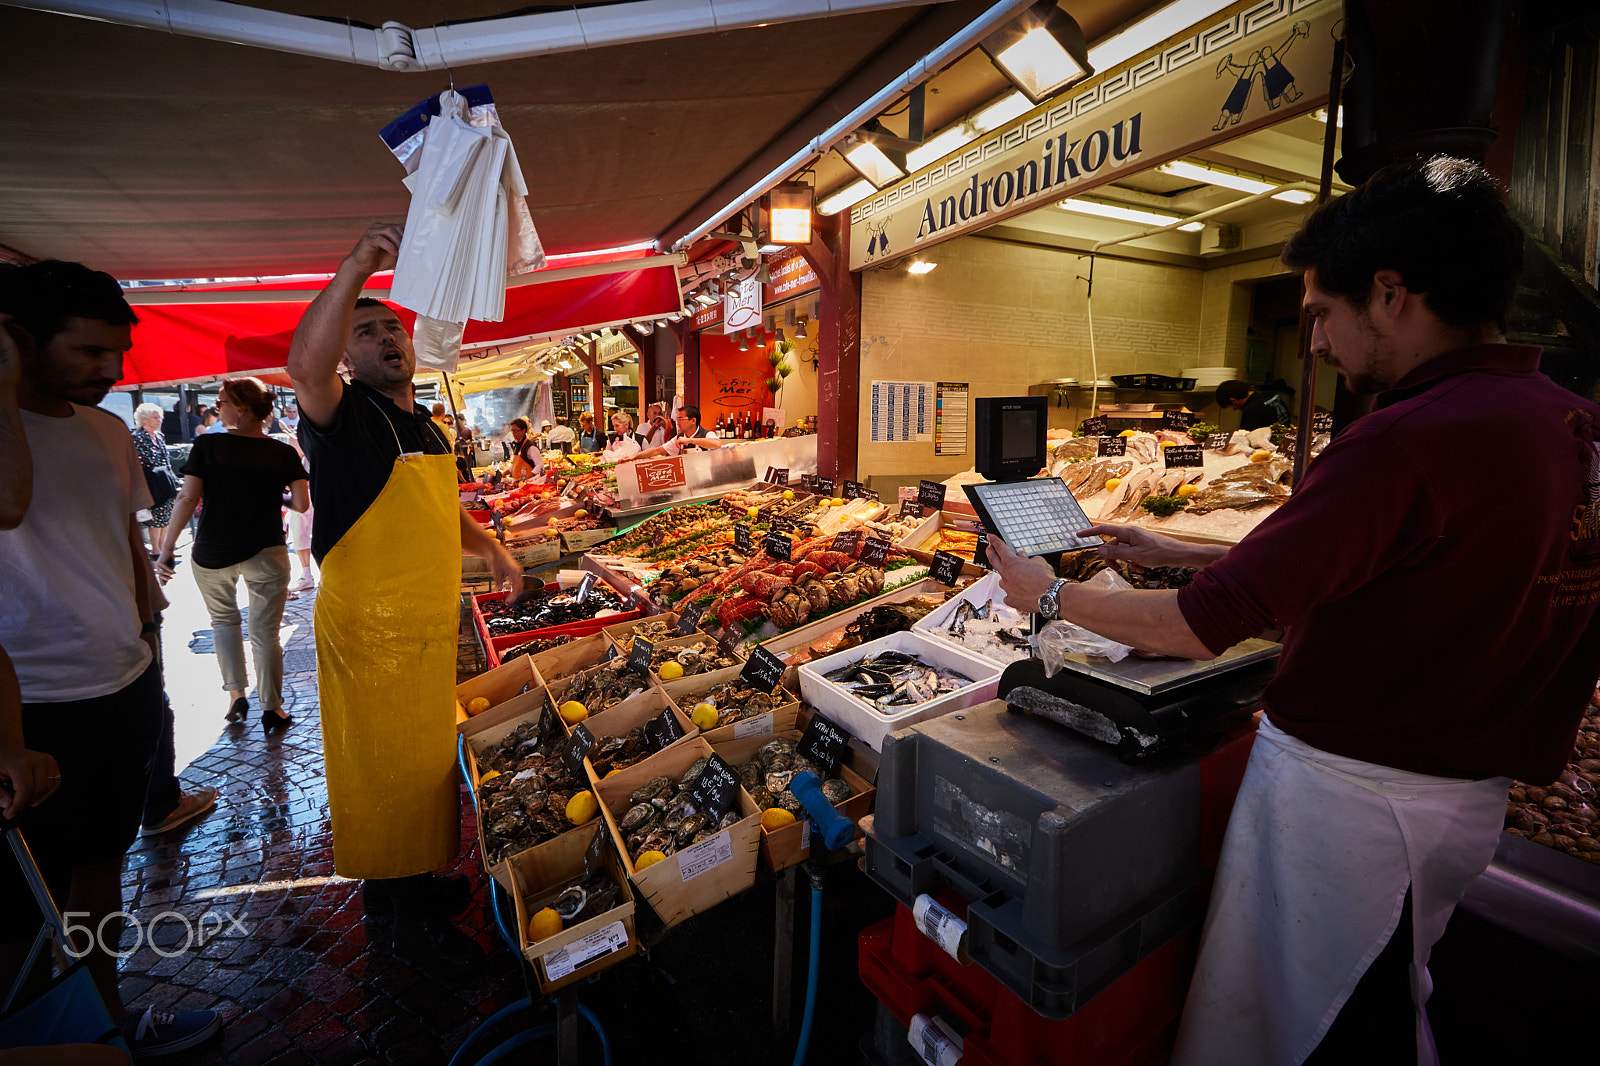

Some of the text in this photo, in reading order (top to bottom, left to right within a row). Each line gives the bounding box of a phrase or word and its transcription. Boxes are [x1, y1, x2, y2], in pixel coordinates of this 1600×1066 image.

[917, 112, 1142, 239] Andronikou
[732, 295, 752, 310] Mer
[719, 386, 755, 394] Mer
[650, 473, 672, 481] Mer
[814, 721, 830, 735] UTAH
